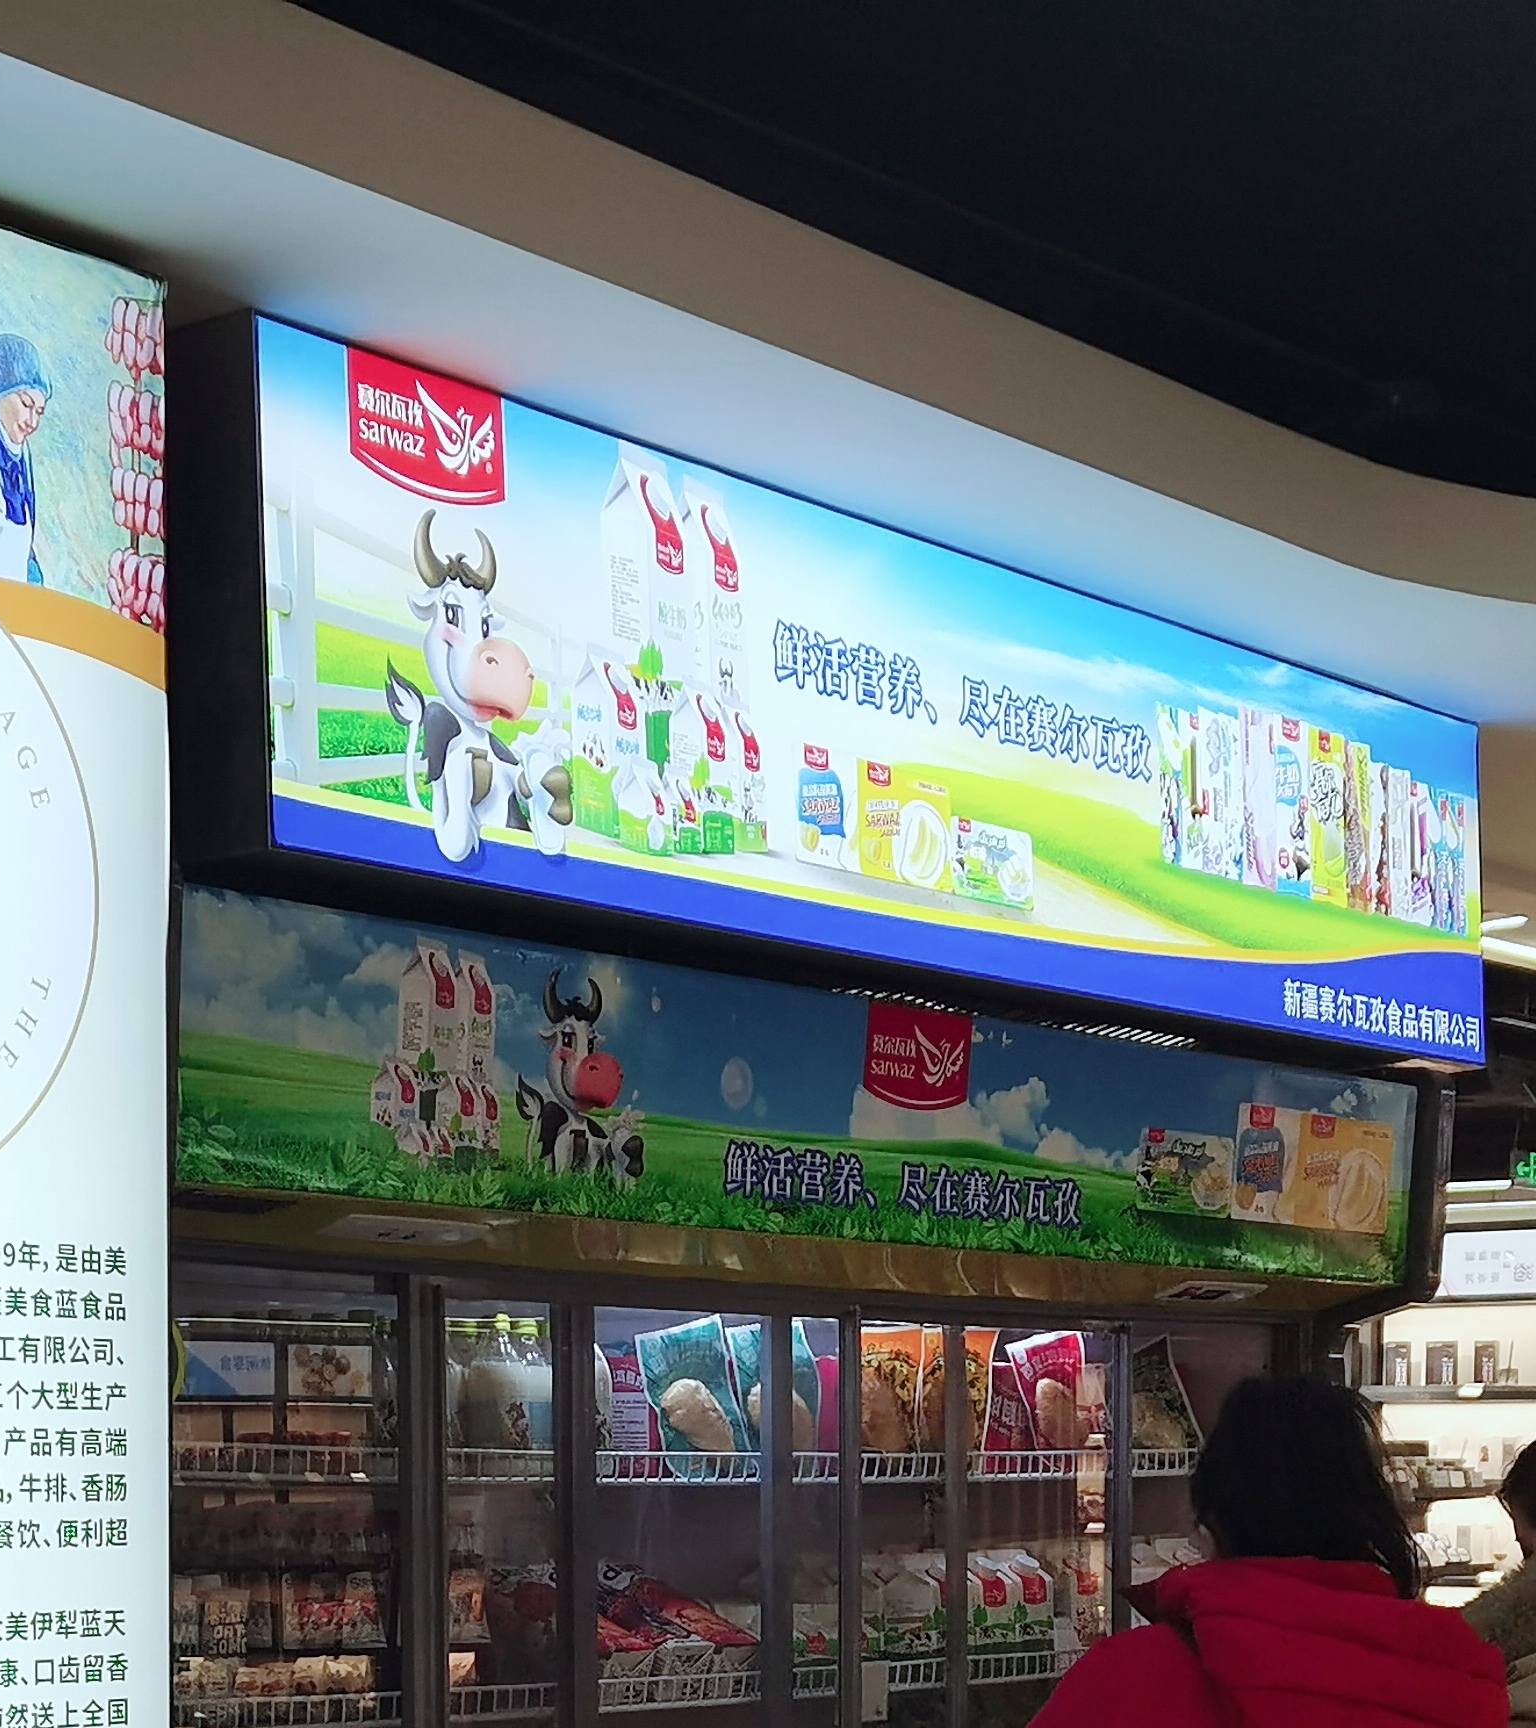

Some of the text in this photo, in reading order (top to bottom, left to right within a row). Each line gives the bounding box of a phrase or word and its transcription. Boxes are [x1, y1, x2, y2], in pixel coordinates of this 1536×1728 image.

[358, 416, 427, 458] sarwaz
[772, 617, 1155, 784] 鲜活营养、尽在赛尔瓦孜
[1282, 976, 1482, 1054] 新疆赛尔瓦孜食品有限公司
[870, 1056, 915, 1082] sarwaz
[722, 1138, 1082, 1228] 鲜活营养、尽在赛尔瓦孜
